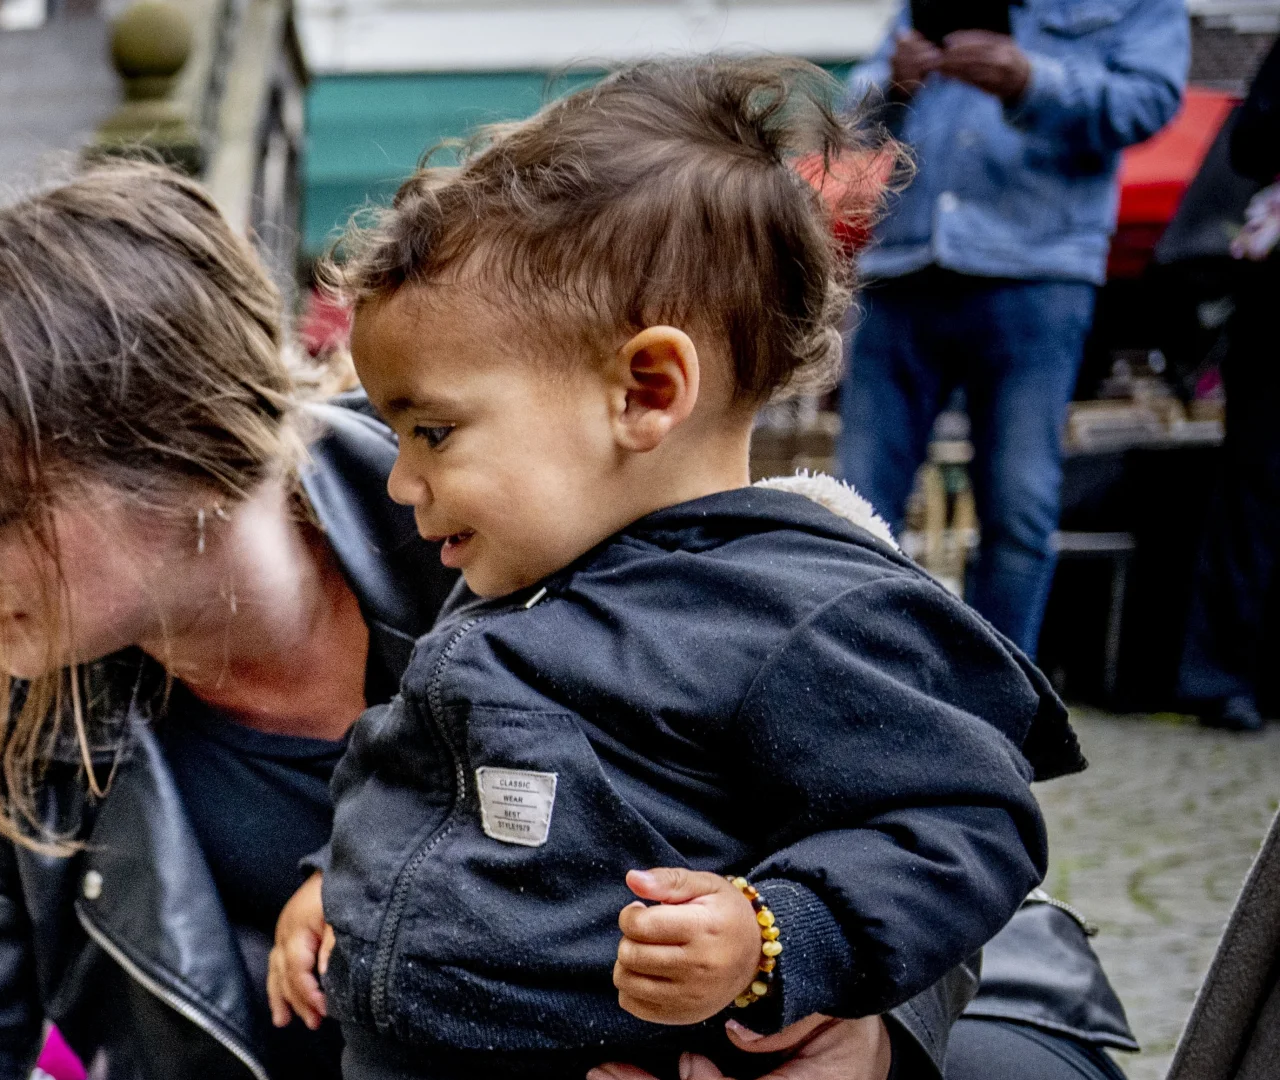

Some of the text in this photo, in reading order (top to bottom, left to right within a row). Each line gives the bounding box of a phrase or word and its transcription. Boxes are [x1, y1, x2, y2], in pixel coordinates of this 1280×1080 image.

[499, 780, 530, 789] CLASSIC
[503, 795, 523, 803] WEAR
[504, 810, 521, 818] BEST
